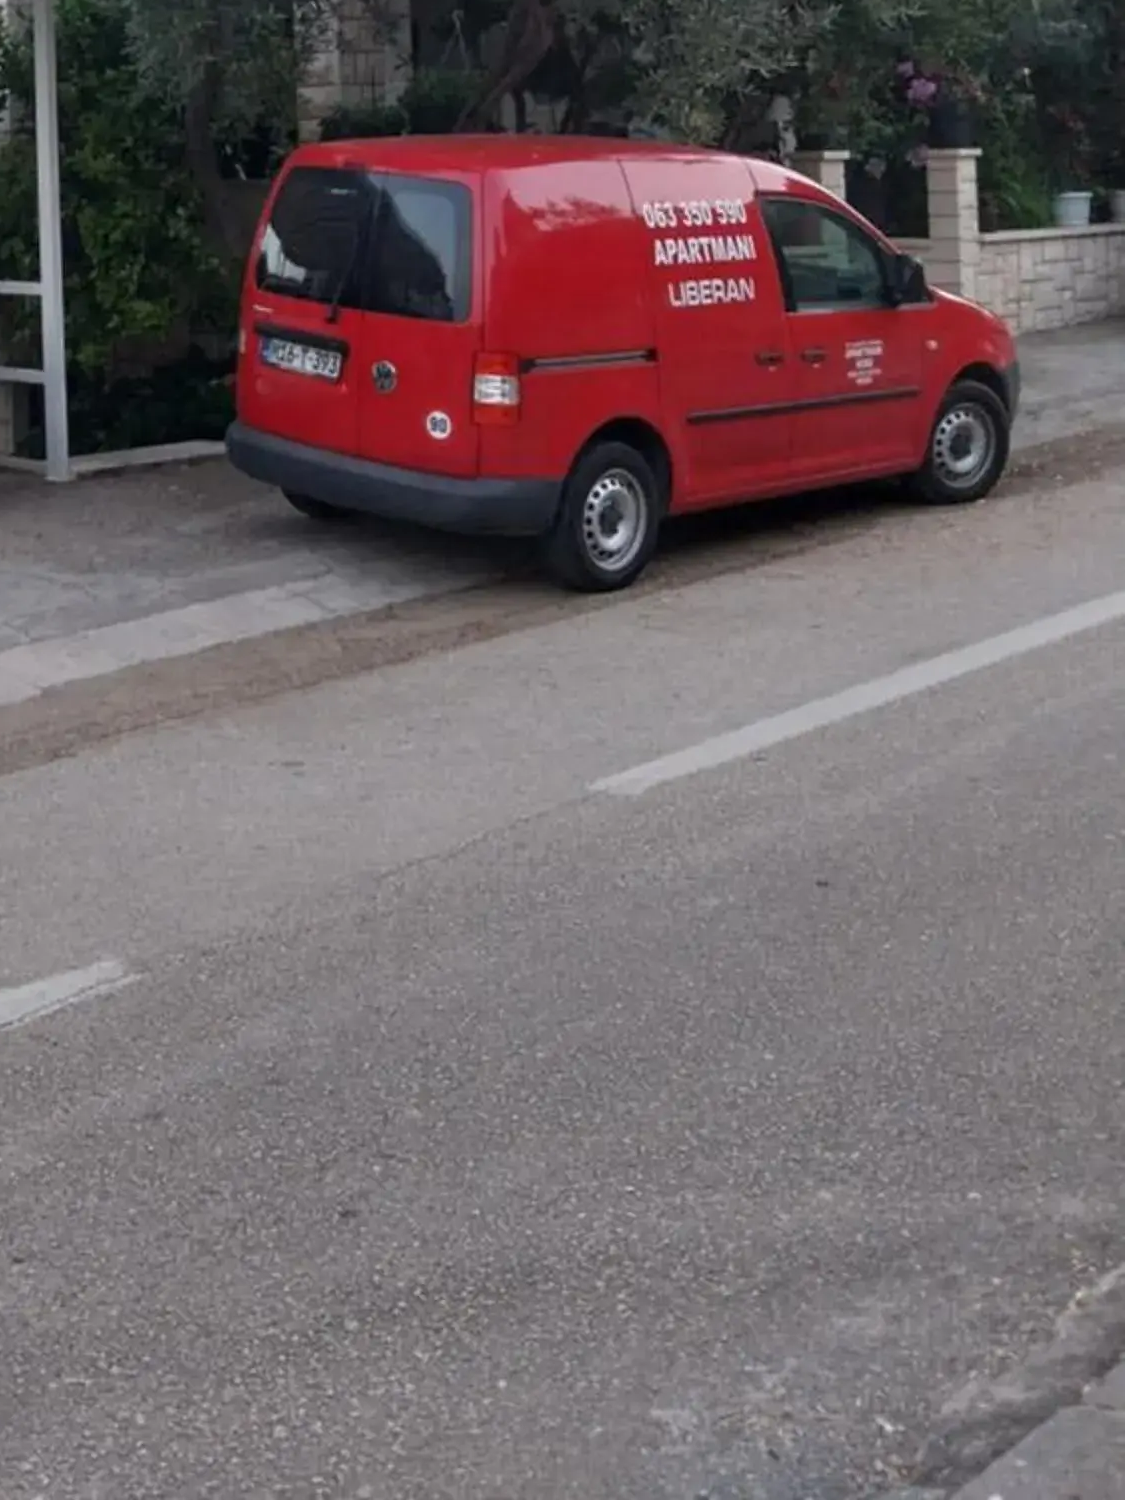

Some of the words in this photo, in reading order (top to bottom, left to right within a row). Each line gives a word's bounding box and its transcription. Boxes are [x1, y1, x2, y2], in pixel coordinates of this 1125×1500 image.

[643, 201, 677, 229] 063
[653, 234, 757, 267] APARTMANI
[668, 277, 756, 308] LIBERAN
